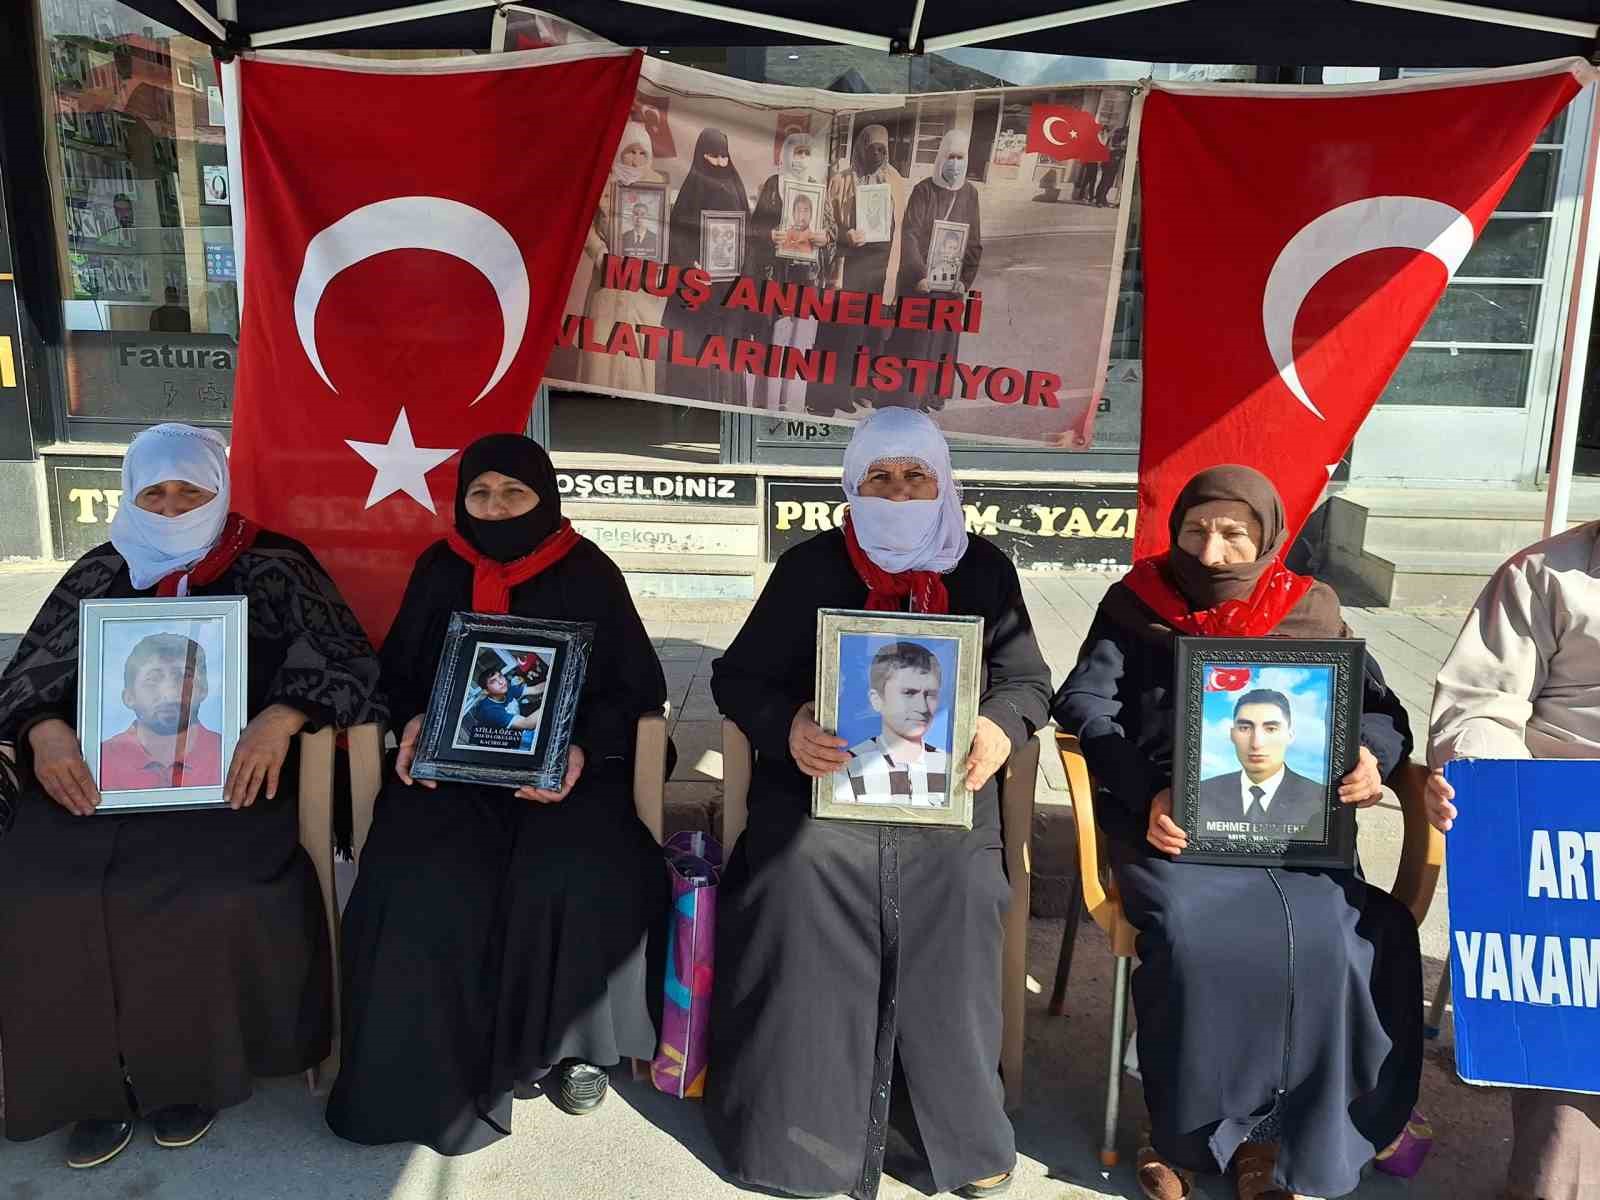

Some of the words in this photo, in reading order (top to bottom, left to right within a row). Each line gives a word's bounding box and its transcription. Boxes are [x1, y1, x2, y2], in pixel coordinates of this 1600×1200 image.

[604, 253, 712, 312] MUŞ
[722, 276, 983, 334] ANNELERİ
[119, 342, 233, 370] Fatura
[852, 344, 1062, 408] İSTİYOR
[787, 421, 831, 441] Mp3
[1206, 821, 1250, 832] MEHMET
[1455, 930, 1600, 1009] YAKAM
